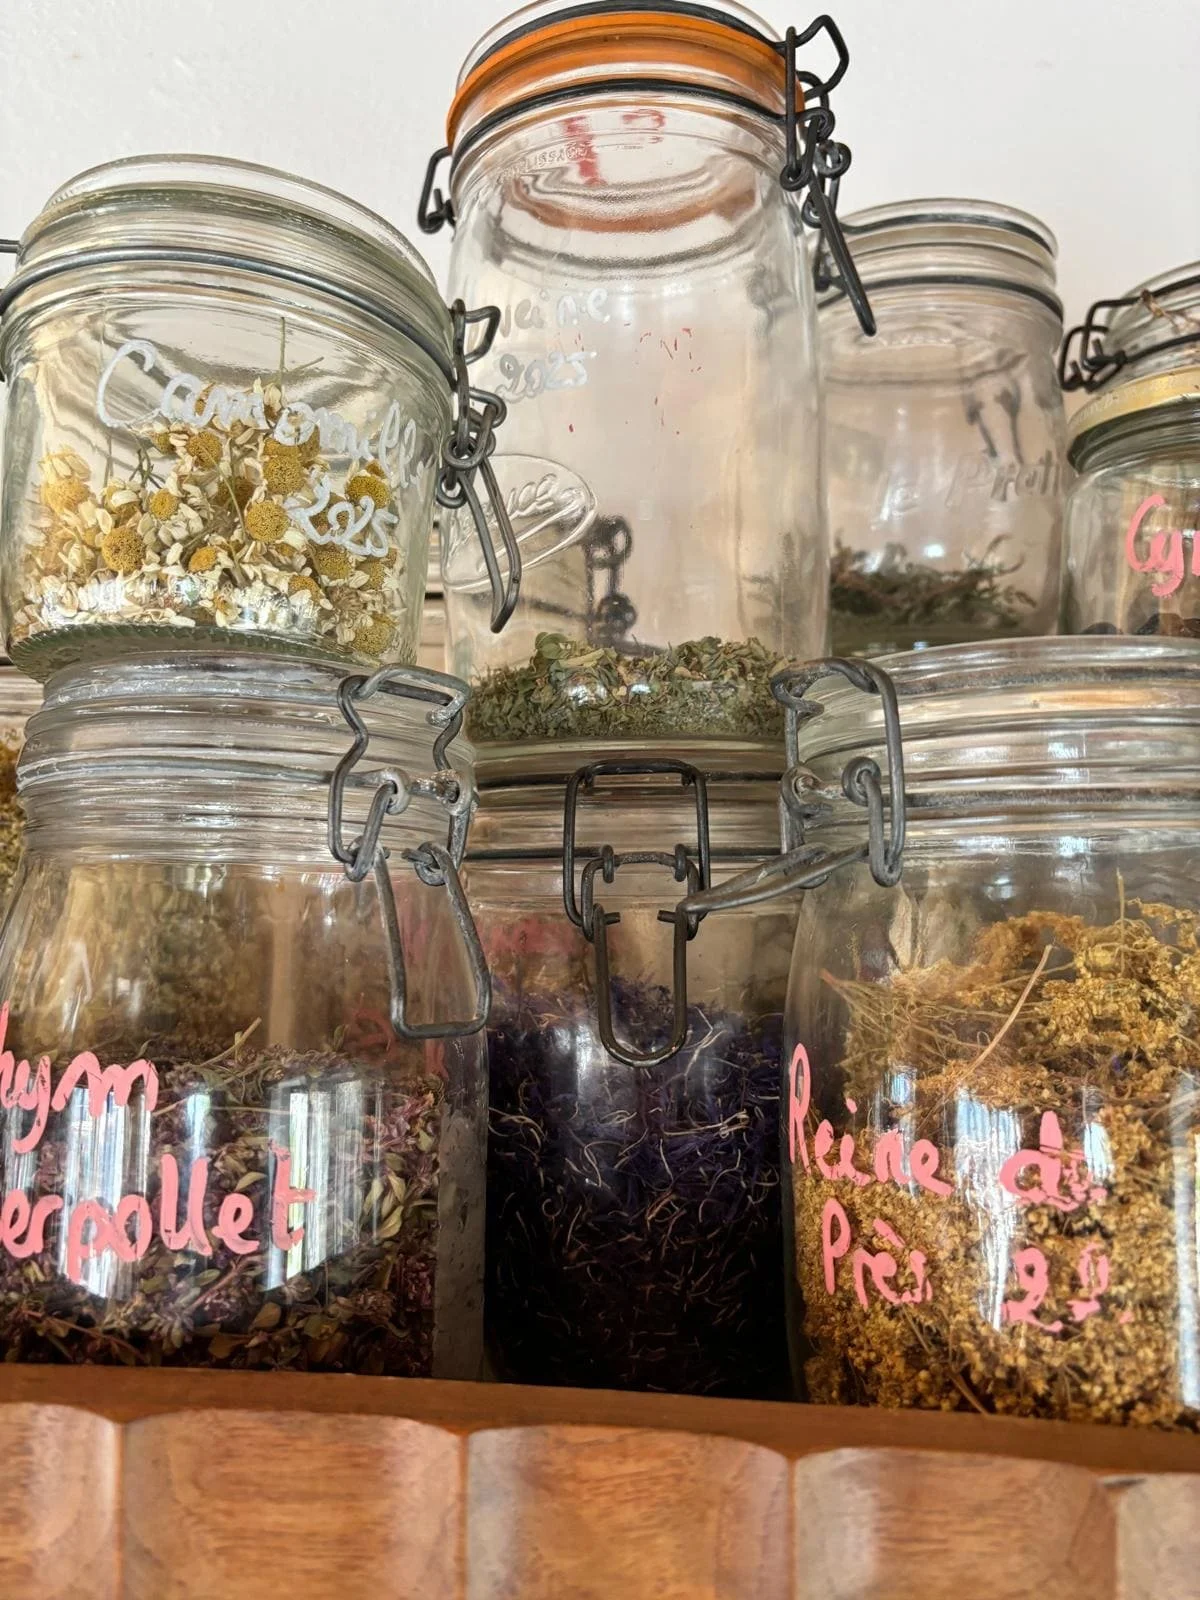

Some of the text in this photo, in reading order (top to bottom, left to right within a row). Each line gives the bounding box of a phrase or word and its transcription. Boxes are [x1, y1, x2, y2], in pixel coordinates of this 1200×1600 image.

[499, 287, 610, 338] veine
[0, 1000, 159, 1153] hym
[788, 1043, 953, 1197] Reine
[0, 1139, 317, 1284] erpollet
